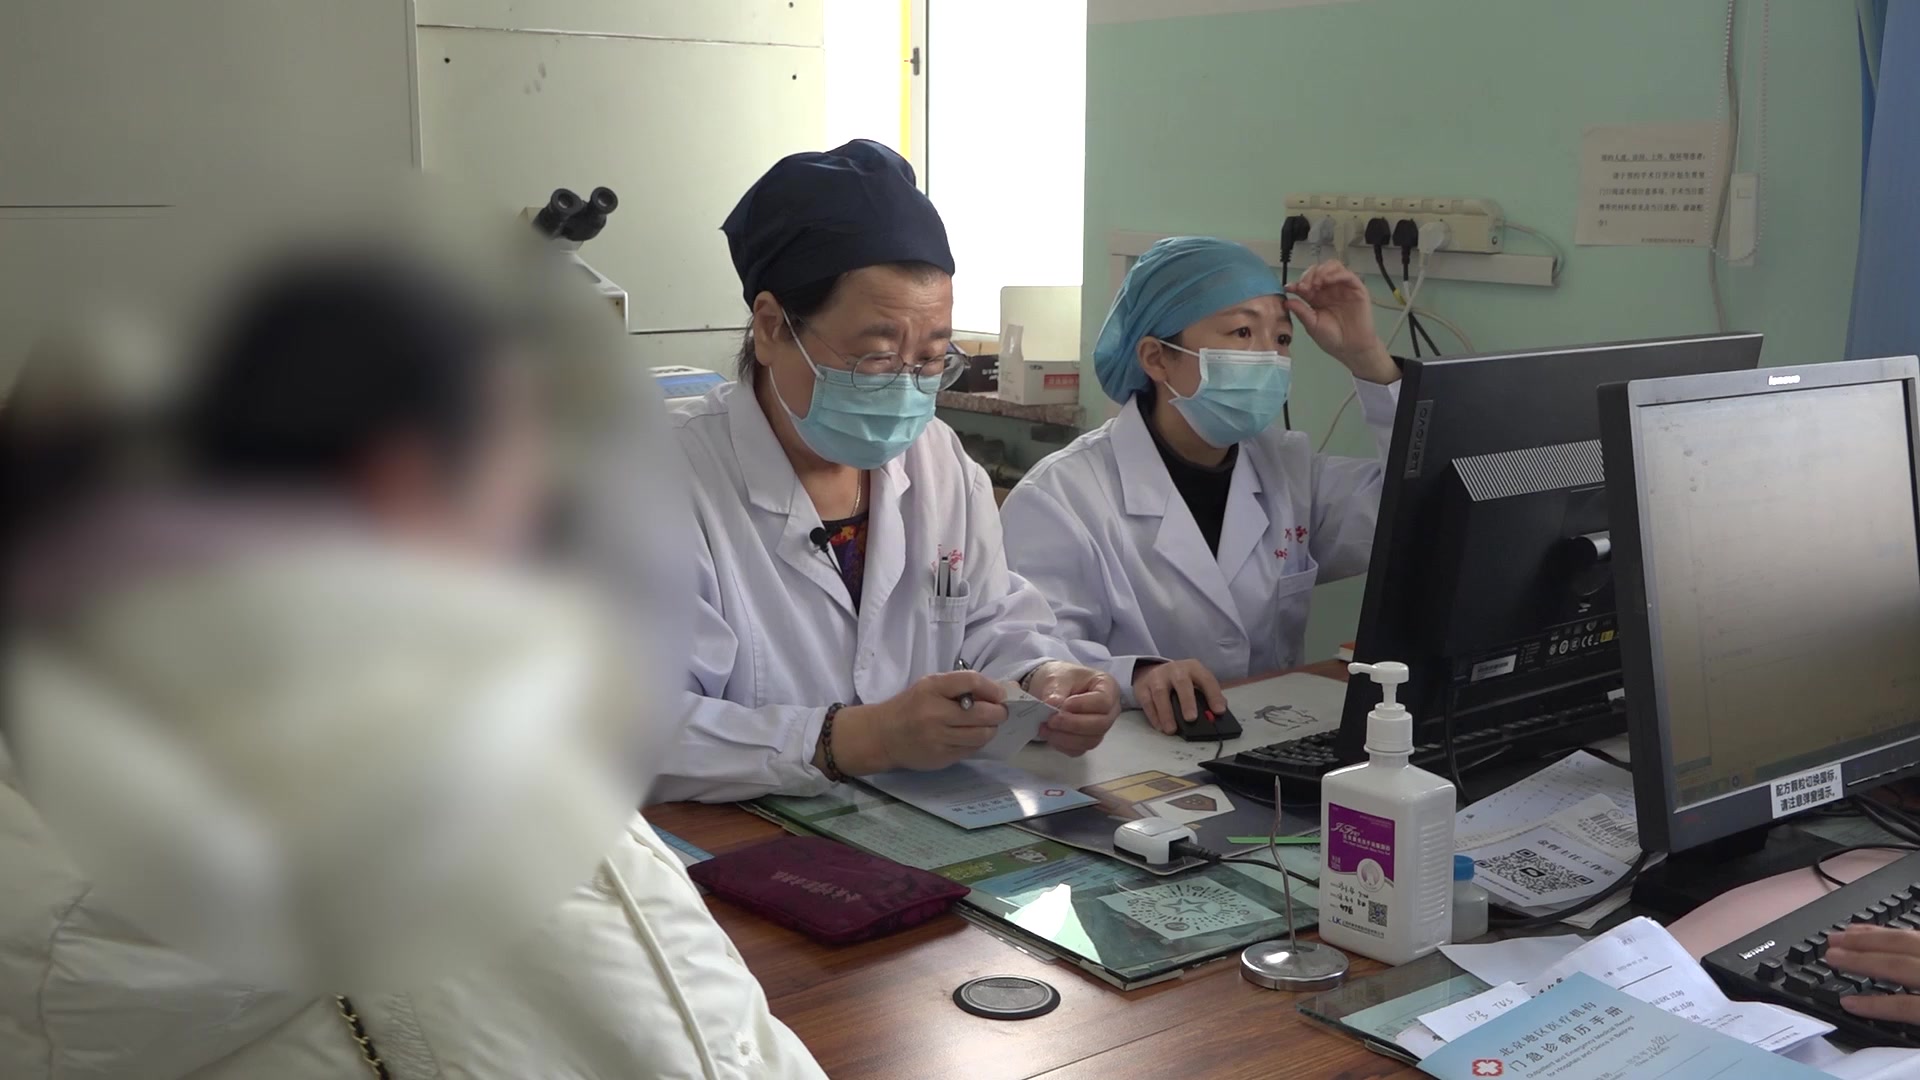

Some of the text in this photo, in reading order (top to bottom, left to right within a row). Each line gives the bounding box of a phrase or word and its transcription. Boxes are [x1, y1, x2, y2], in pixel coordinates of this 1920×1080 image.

[1407, 406, 1429, 472] Lenovo
[1739, 939, 1776, 960] lenovo
[1499, 1001, 1597, 1057] 北京地区医疗机构
[1508, 1006, 1624, 1072] 门急诊病历手册
